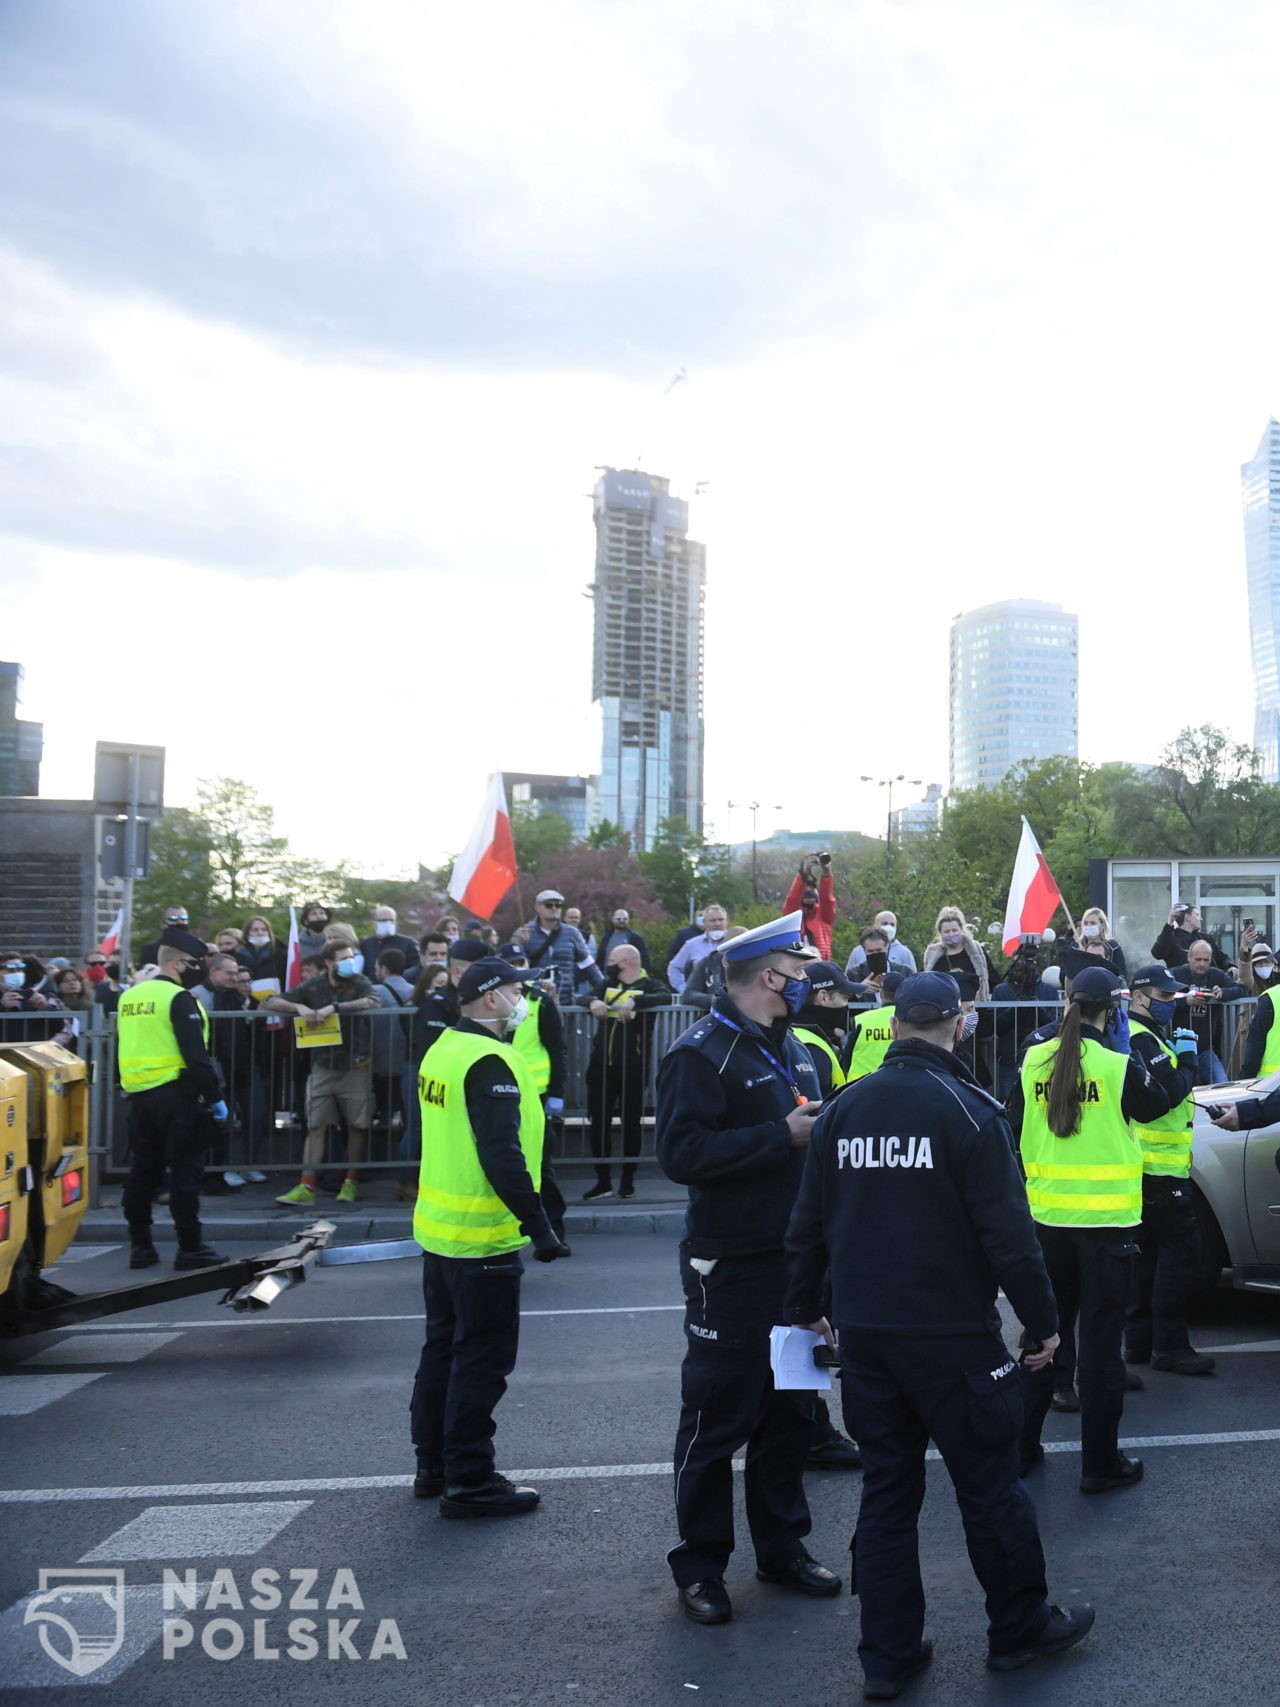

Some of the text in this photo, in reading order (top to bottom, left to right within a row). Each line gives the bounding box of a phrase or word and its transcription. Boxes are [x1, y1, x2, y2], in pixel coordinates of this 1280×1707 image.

[812, 980, 835, 990] POLICJA
[121, 1001, 156, 1017] POLICJA
[865, 1028, 893, 1042] POLI
[1035, 1081, 1100, 1102] POJA
[838, 1136, 934, 1169] POLICJA
[690, 1323, 718, 1341] POLICJA
